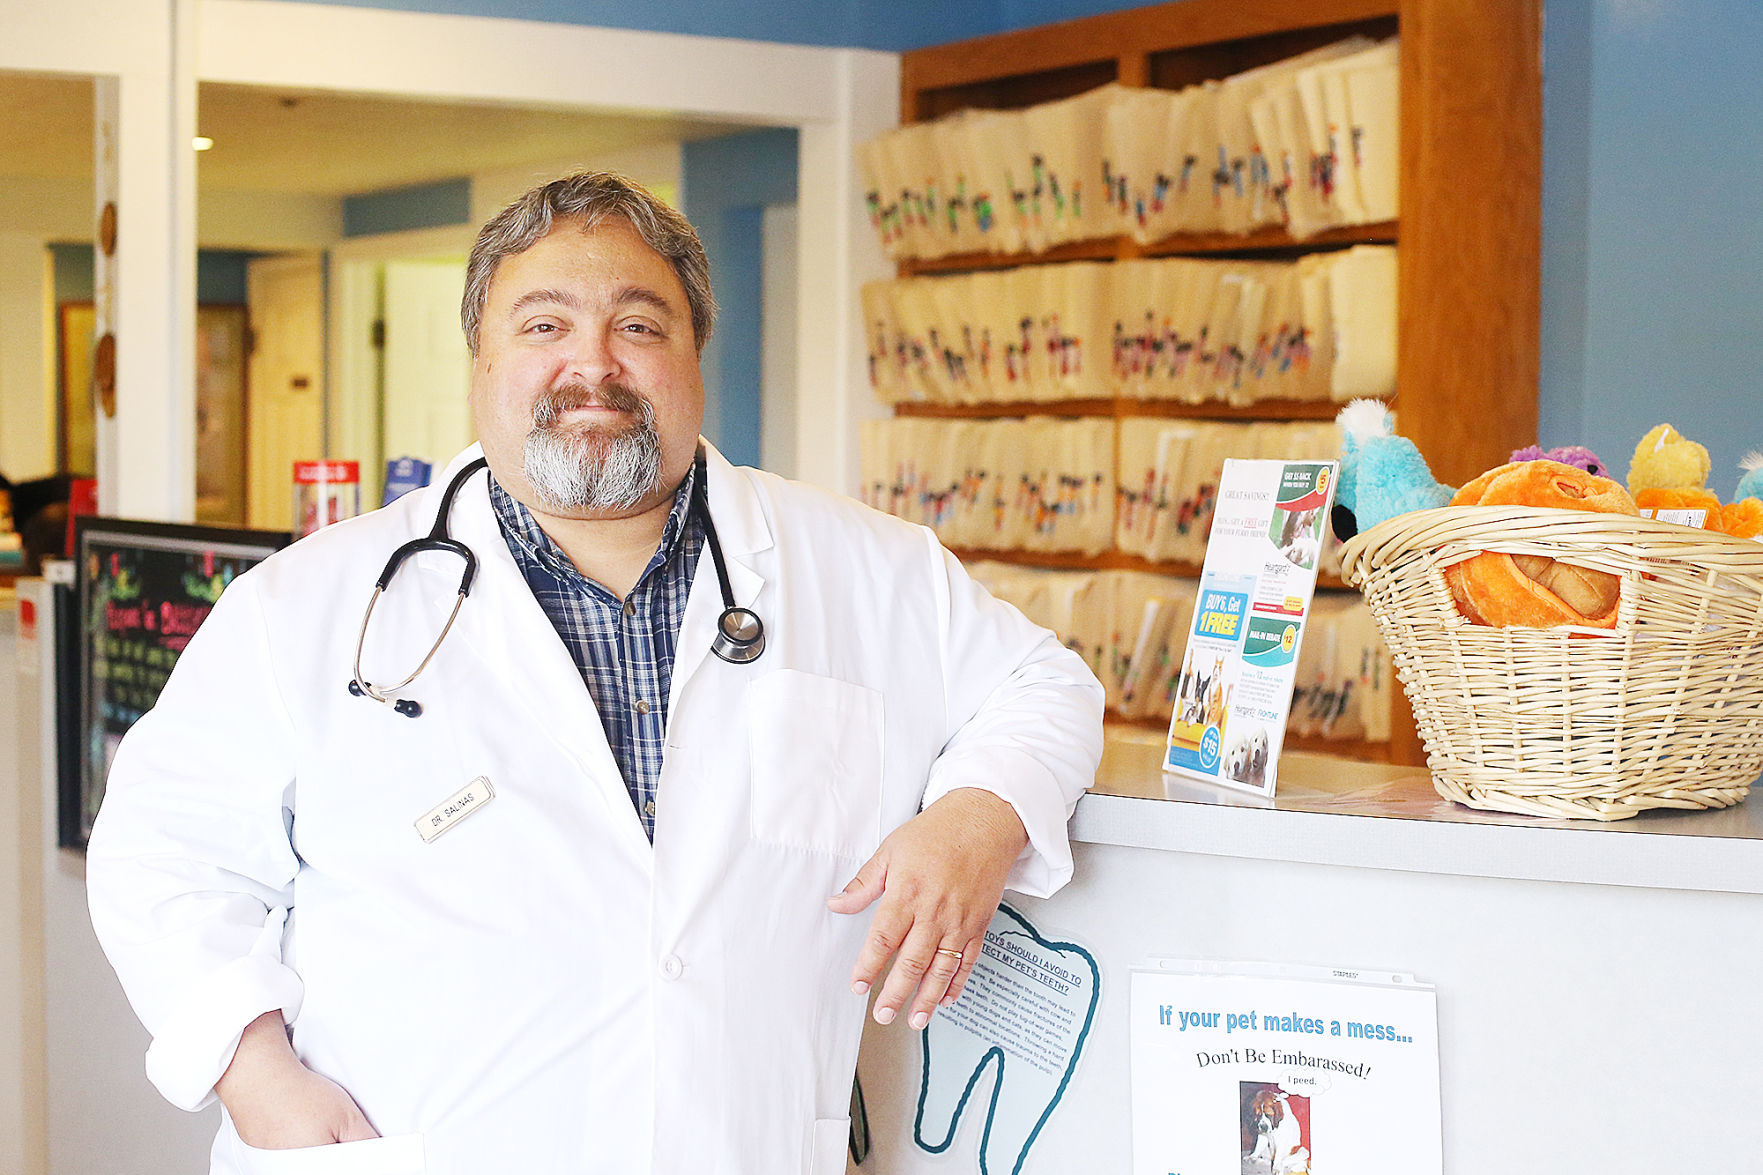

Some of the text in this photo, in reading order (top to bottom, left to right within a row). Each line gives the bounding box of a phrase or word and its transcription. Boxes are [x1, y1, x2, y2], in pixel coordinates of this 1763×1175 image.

[1224, 489, 1243, 499] GREAT
[1227, 596, 1242, 613] Get
[1199, 611, 1240, 636] 1 FREE
[1203, 737, 1218, 756] $15
[444, 792, 475, 818] SALINAS
[982, 943, 1070, 993] TECT MY PET'S TEETH?
[984, 930, 1005, 946] TOYS
[1006, 941, 1039, 963] SHOULD
[1043, 960, 1069, 979] AVOID
[1070, 973, 1082, 986] TO
[1159, 1004, 1413, 1043] If your pet makes a mess...
[1195, 1048, 1372, 1080] Don't Be Embarassed!
[1287, 1075, 1317, 1086] I peed.
